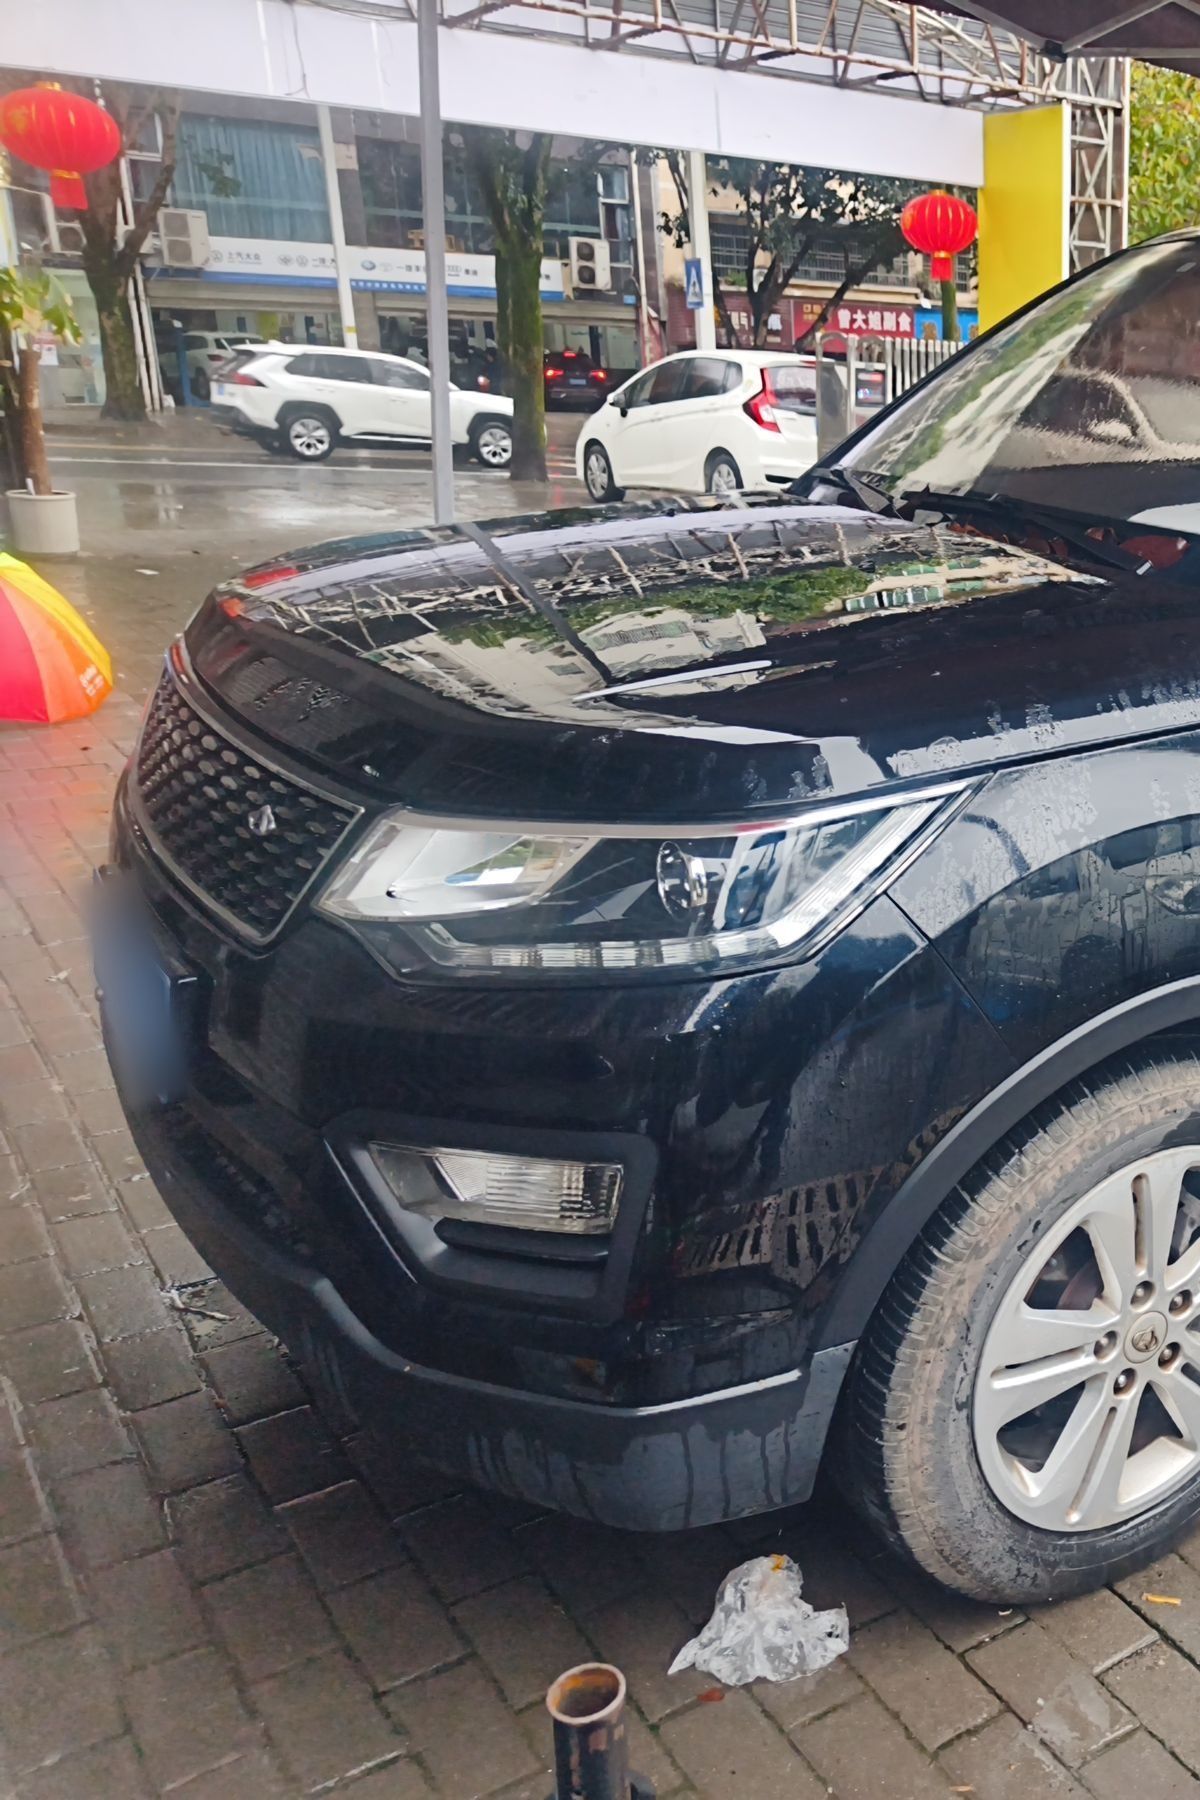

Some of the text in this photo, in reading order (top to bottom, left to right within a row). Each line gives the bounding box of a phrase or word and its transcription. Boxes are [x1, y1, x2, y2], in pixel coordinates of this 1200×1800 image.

[837, 308, 912, 332] 曾大姐副食
